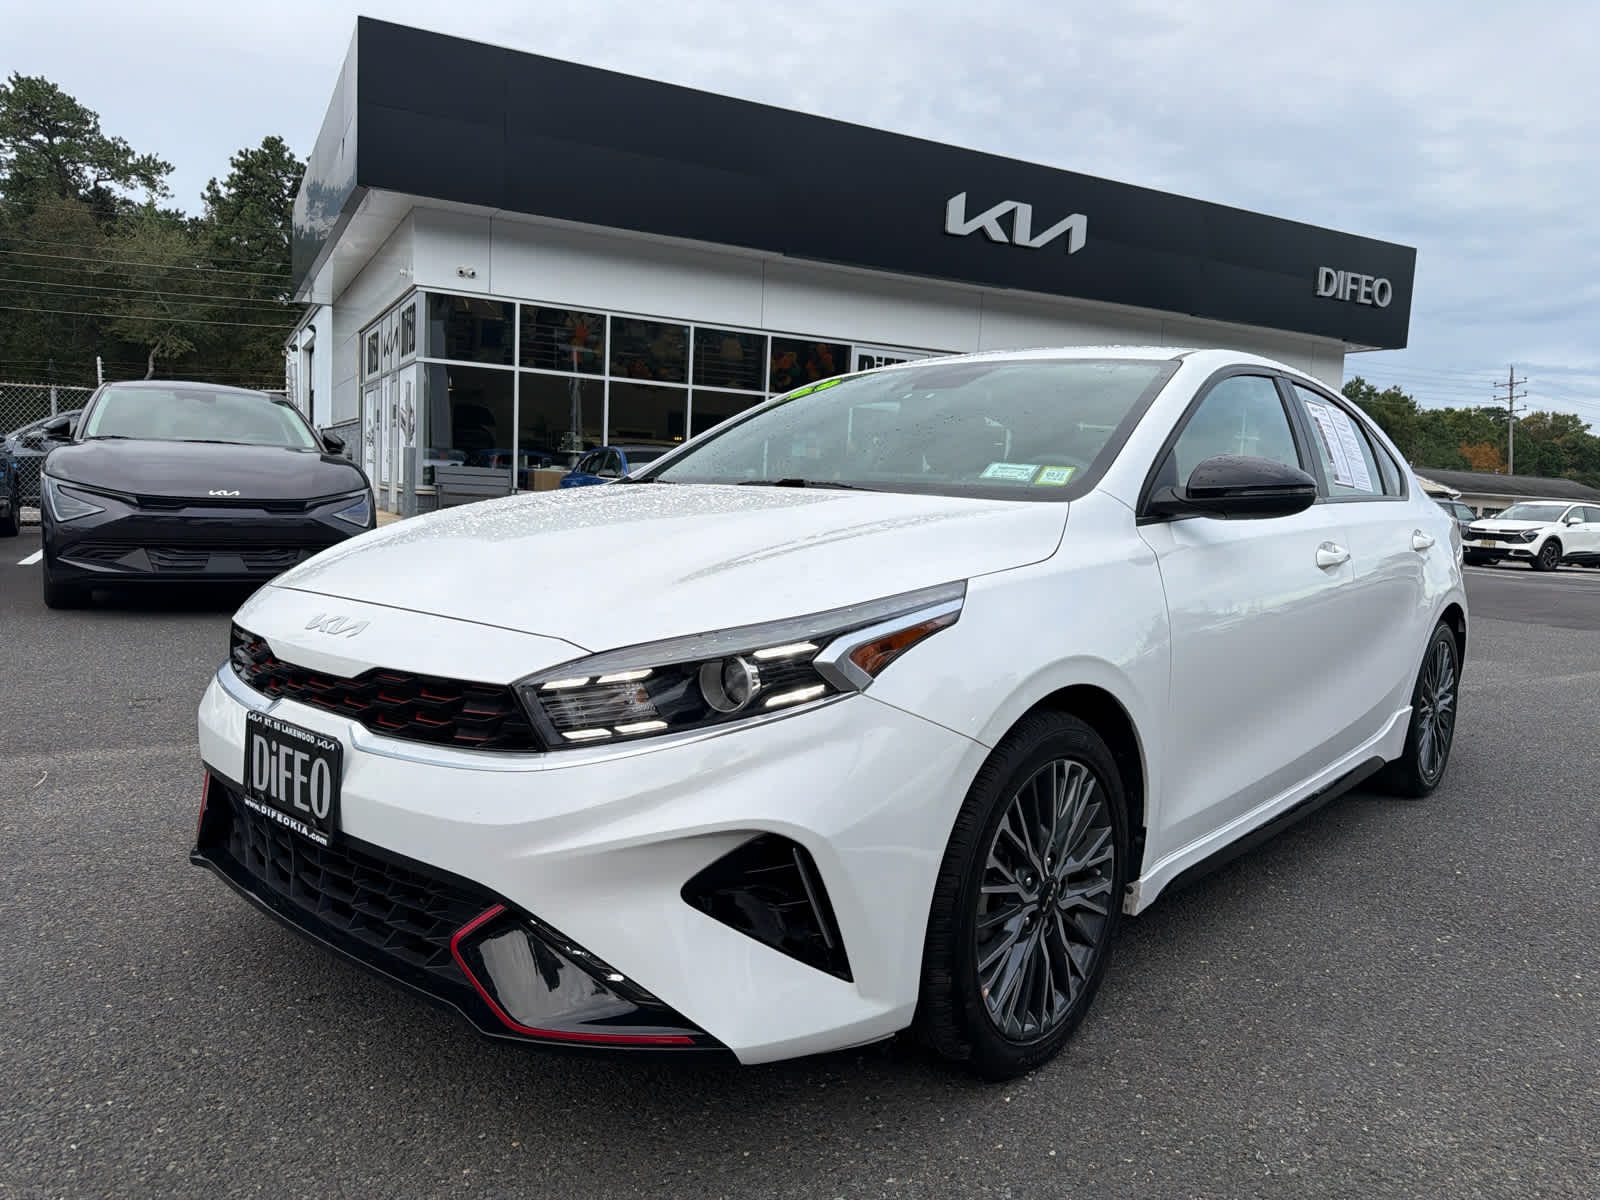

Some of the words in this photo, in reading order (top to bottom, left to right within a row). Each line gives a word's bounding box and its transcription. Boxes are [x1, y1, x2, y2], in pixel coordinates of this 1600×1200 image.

[945, 191, 1088, 255] KIA
[1316, 266, 1393, 309] DIFEO
[304, 613, 370, 638] KIA
[281, 724, 315, 744] LAKEWOOD
[252, 733, 331, 819] DiFEO
